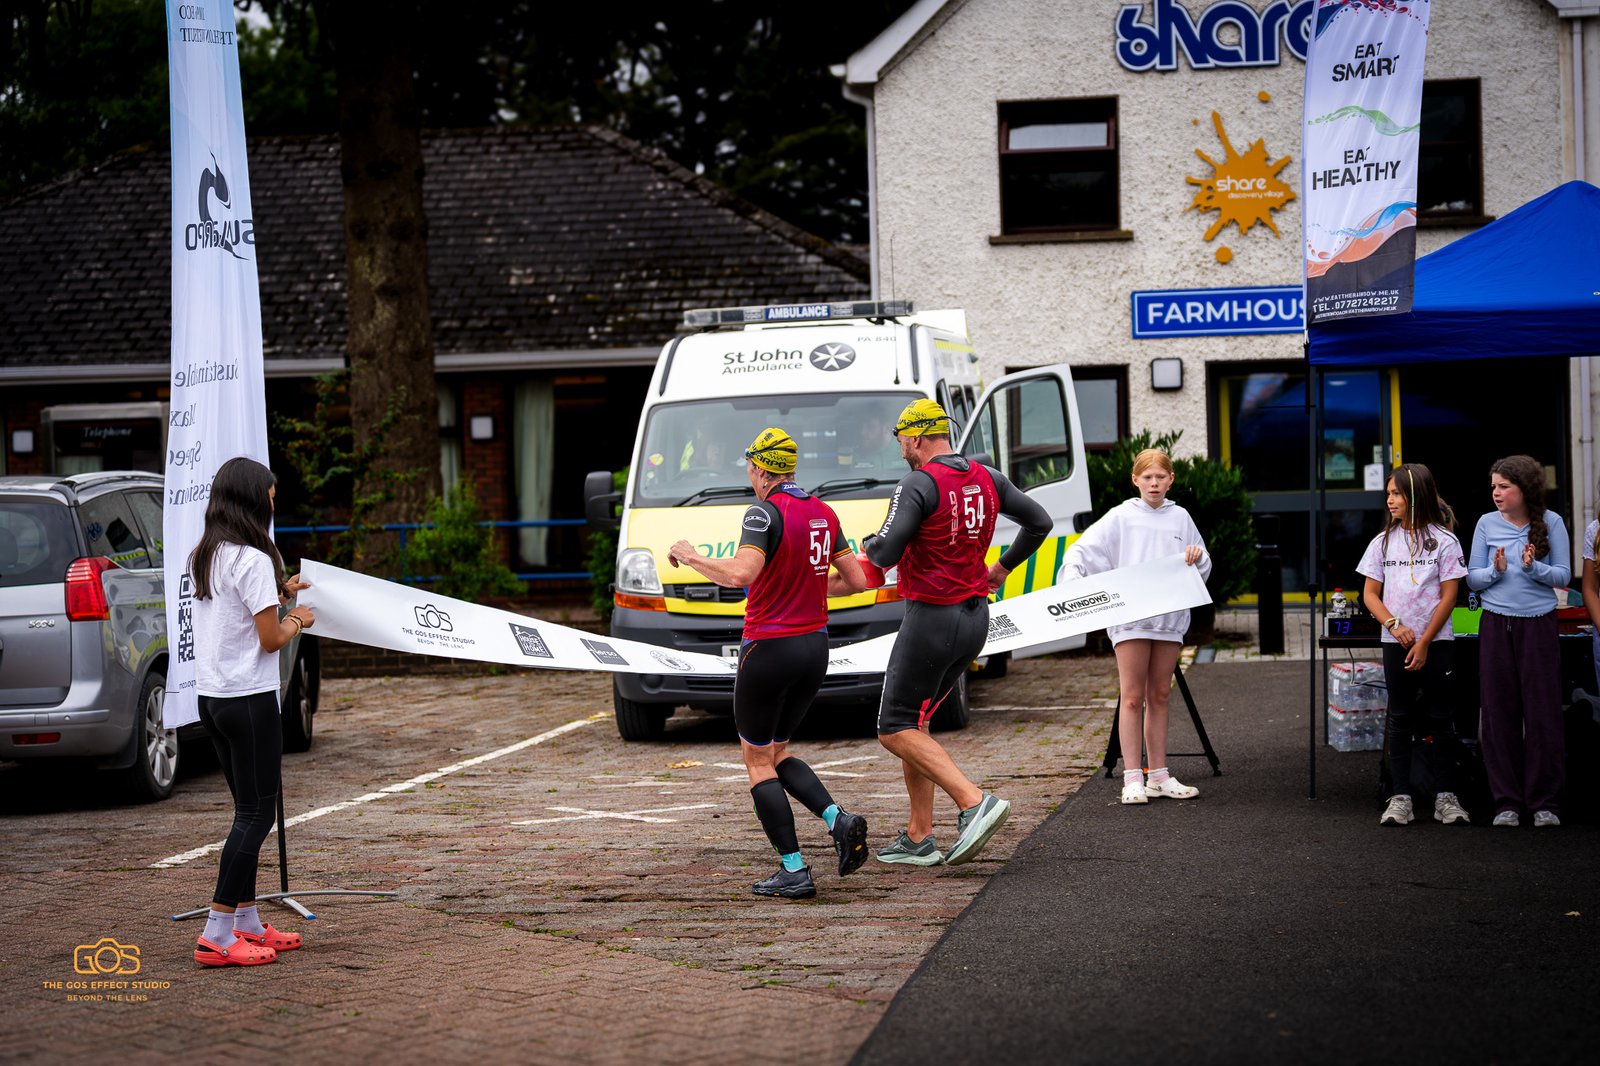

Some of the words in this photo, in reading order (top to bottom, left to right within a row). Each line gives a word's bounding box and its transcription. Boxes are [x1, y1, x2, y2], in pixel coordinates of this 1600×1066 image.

[1355, 42, 1383, 59] EAT
[1332, 55, 1400, 82] SMART
[1216, 175, 1267, 192] share
[1312, 160, 1401, 191] HEALTHY
[768, 305, 828, 320] AMBULANCE
[1147, 298, 1305, 325] FARMHOU
[722, 362, 803, 375] Ambulance
[723, 351, 744, 365] St
[750, 348, 803, 363] John
[880, 485, 903, 538] SWIMRUN
[949, 490, 959, 545] HEAD
[963, 495, 986, 529] 54
[810, 530, 831, 565] 54
[1047, 601, 1073, 617] OK
[1067, 594, 1108, 610] WINDOWS
[451, 636, 476, 645] STUDIO
